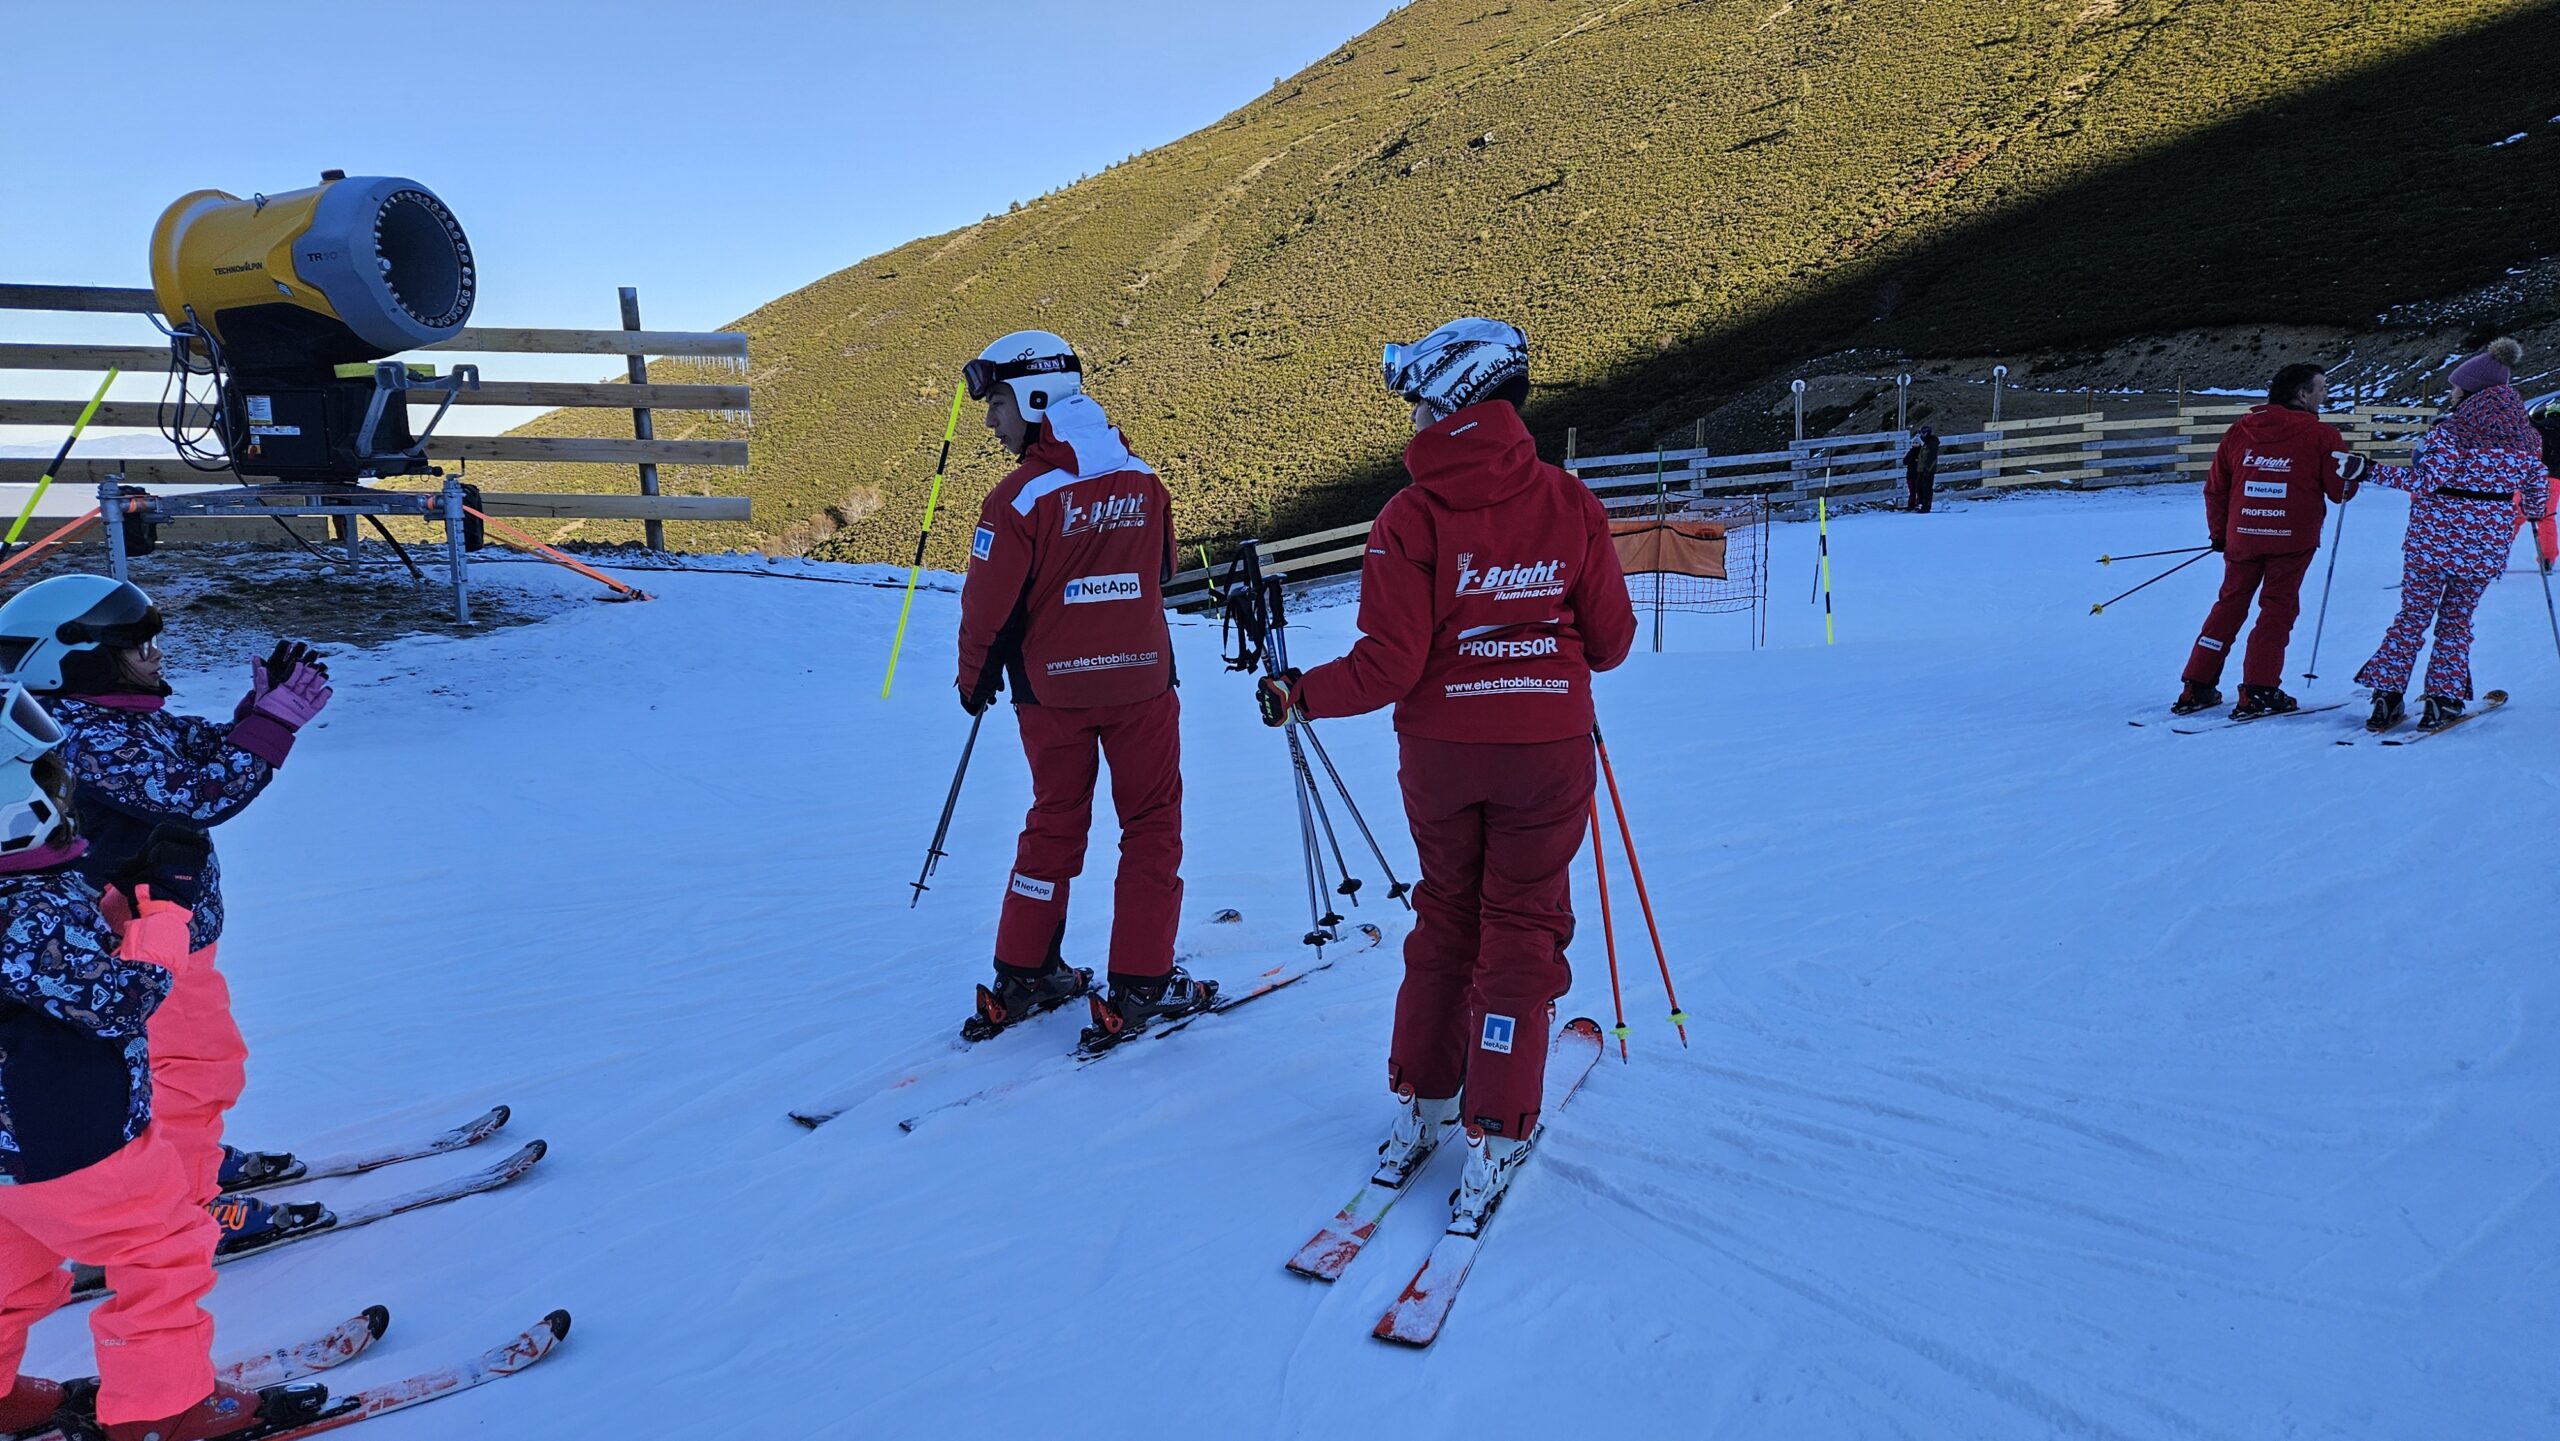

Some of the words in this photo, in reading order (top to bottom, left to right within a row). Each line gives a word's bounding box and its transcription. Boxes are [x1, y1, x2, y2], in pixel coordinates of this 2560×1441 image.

[1010, 348, 1035, 363] OC
[2254, 486, 2283, 494] NetApp
[2241, 507, 2286, 517] PROFESOR
[1081, 580, 1138, 595] NetApp
[1494, 585, 1563, 601] iluminación
[1458, 636, 1559, 658] PROFESOR
[1046, 651, 1159, 671] www.electrobilsa.com
[1445, 676, 1569, 692] www.electrobilsa.com
[1020, 881, 1050, 895] NetApp
[1483, 1040, 1509, 1051] NetApp
